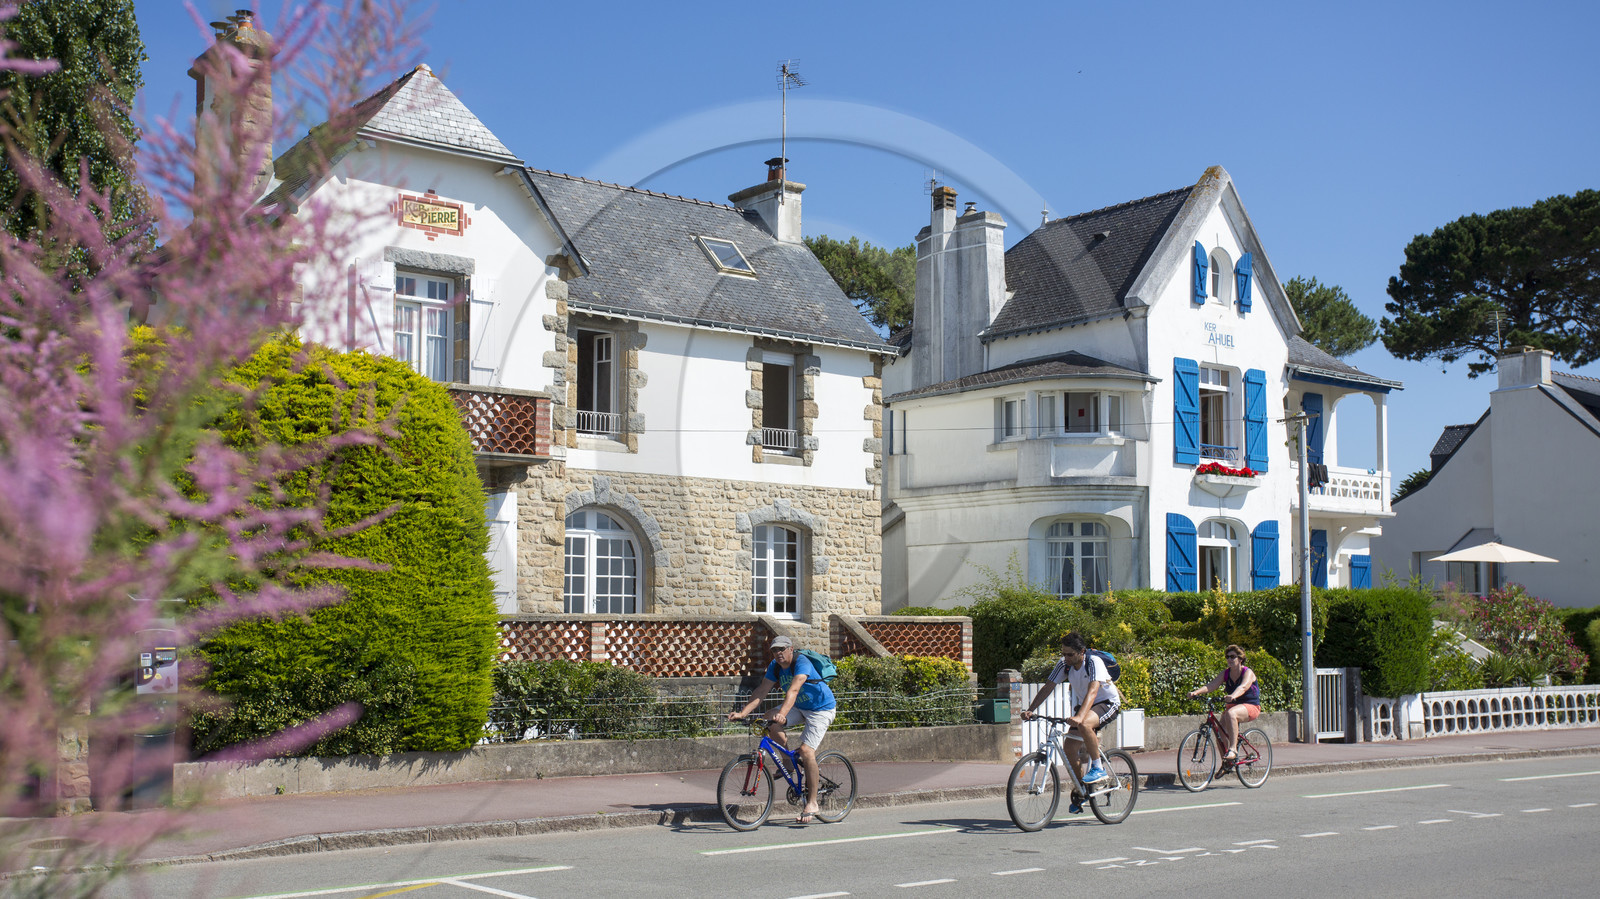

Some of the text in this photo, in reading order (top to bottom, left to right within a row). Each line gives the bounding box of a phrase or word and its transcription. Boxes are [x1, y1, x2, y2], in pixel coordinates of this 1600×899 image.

[404, 201, 429, 217] KER
[1204, 321, 1217, 332] KER
[1208, 332, 1235, 348] AHUEL
